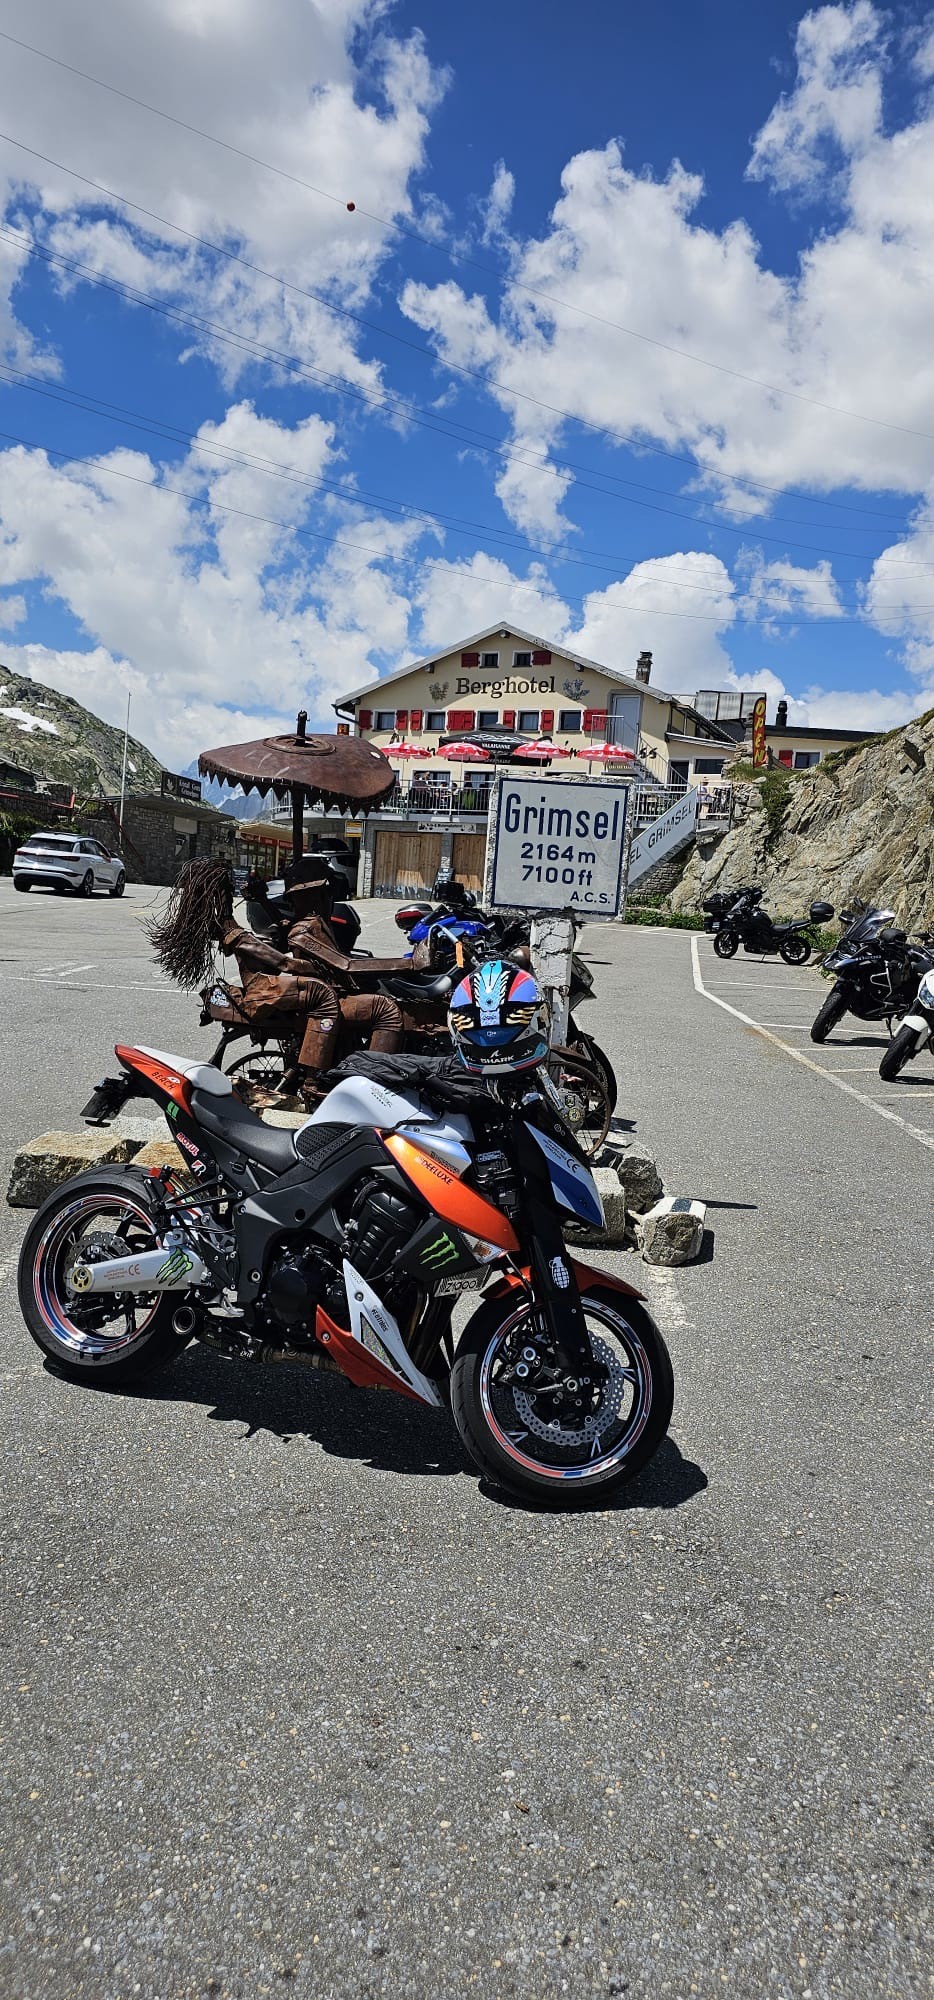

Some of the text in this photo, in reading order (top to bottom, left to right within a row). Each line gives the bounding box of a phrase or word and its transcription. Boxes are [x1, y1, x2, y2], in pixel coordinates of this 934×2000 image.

[455, 676, 556, 699] Berghotel
[755, 702, 766, 763] OPEN
[504, 793, 620, 841] Grimsel
[481, 1055, 515, 1064] SHARK
[175, 1131, 200, 1157] MOTUL
